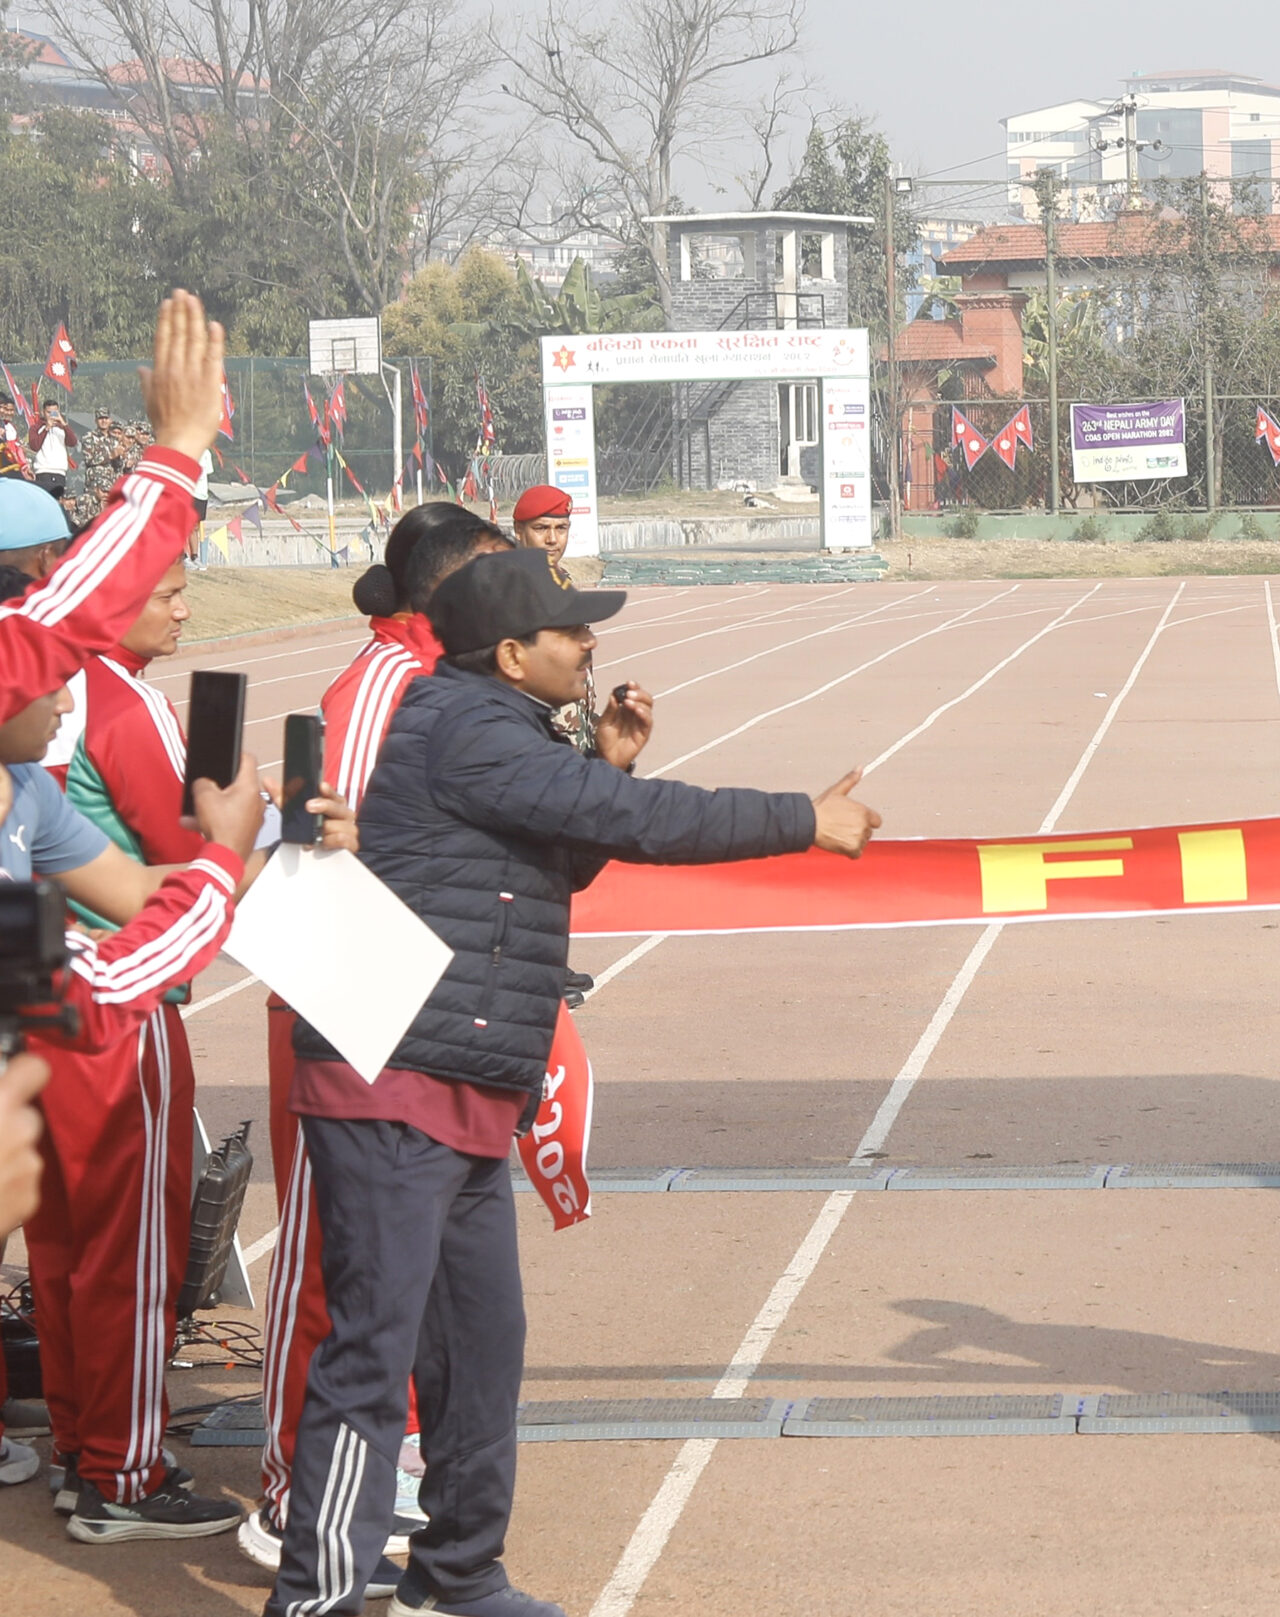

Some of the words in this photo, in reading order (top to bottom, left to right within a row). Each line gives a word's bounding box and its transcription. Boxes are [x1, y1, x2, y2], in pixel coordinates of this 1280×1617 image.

[586, 336, 643, 352] बलियो
[649, 337, 698, 351] एकता
[716, 333, 779, 351] सुरक्षित
[1082, 420, 1103, 432] 263rd
[1104, 418, 1133, 431] NEPALI
[1135, 416, 1158, 428] ARMY
[1160, 415, 1176, 427] DAY
[1085, 434, 1102, 442] COAS
[1103, 432, 1120, 440] OPEN
[1122, 430, 1157, 439] MARATHON
